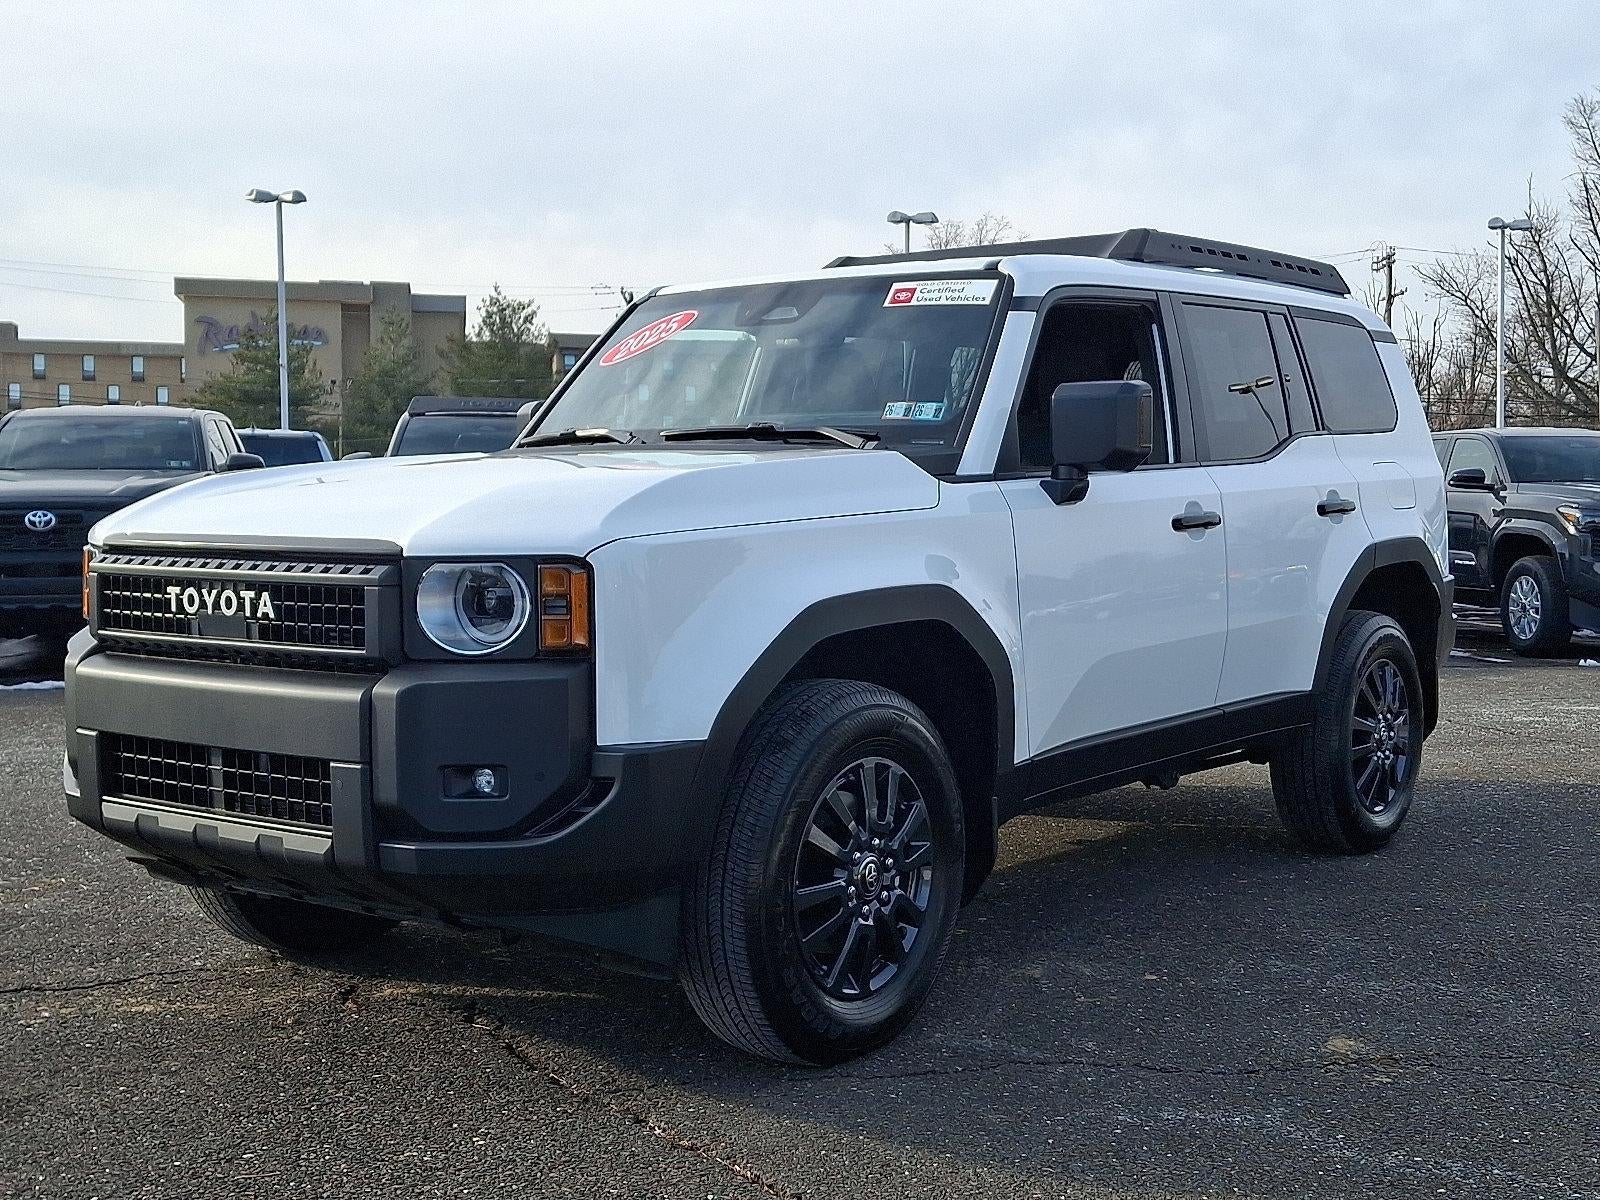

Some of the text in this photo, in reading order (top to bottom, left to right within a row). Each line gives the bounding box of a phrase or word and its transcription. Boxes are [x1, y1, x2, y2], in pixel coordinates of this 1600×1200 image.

[919, 286, 965, 294] Certified
[945, 294, 986, 302] Vehicles
[612, 313, 685, 362] 2025
[166, 585, 275, 619] TOYOTA
